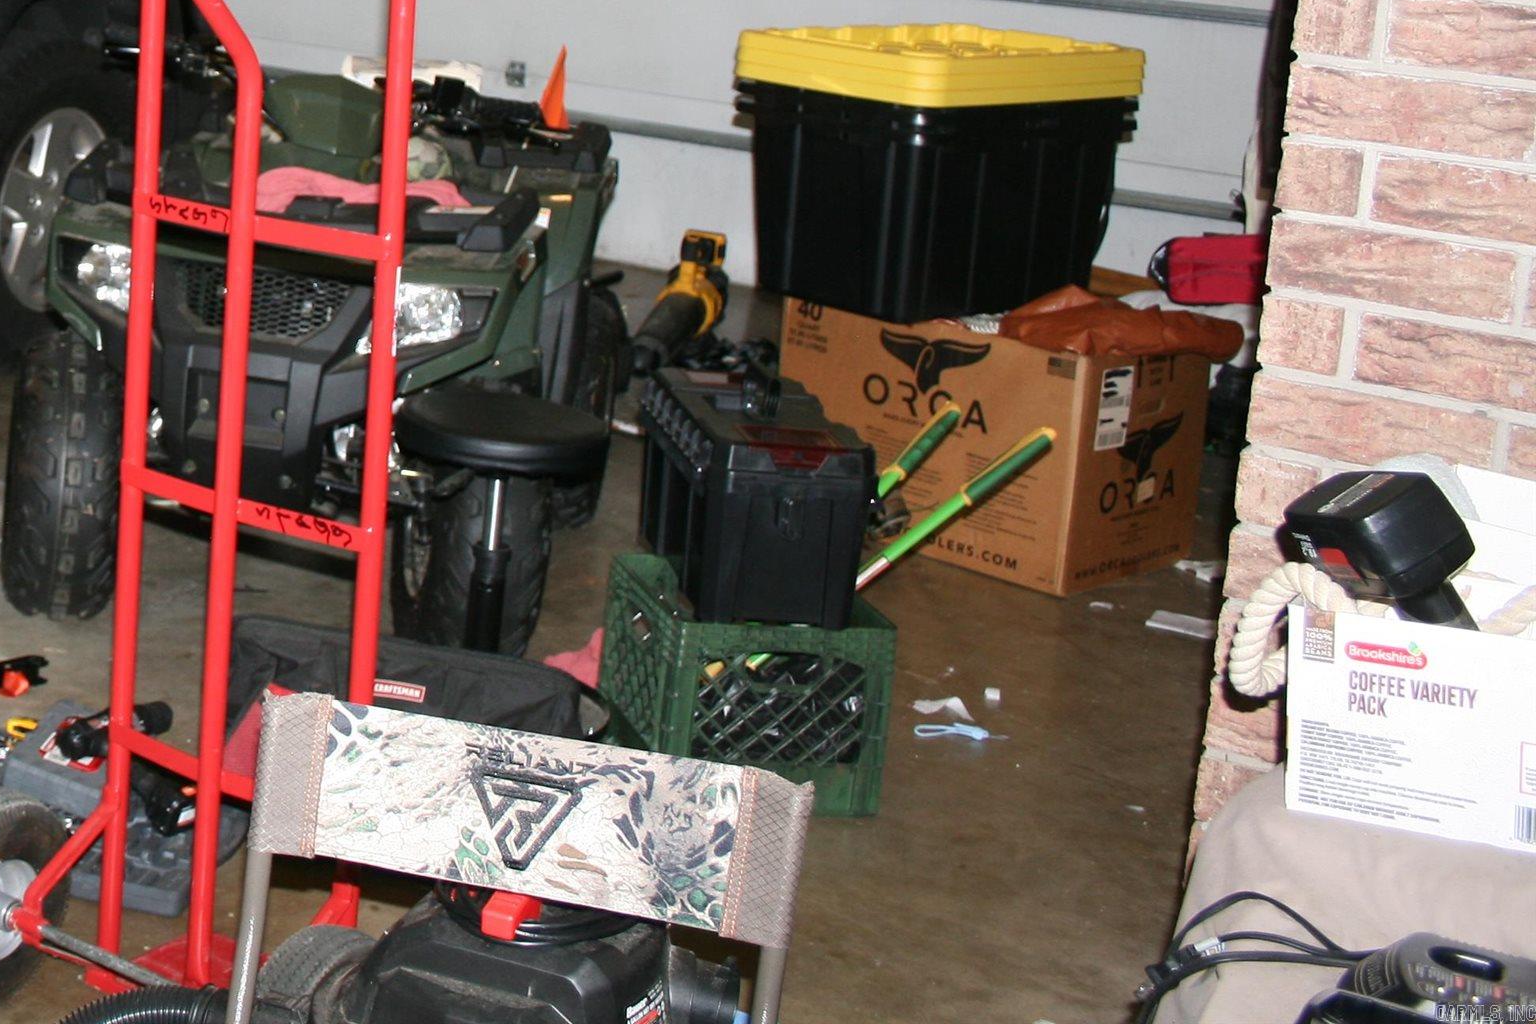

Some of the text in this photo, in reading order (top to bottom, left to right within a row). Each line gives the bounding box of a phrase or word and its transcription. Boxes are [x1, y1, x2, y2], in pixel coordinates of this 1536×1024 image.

[798, 298, 823, 321] 40
[1100, 469, 1175, 514] ORA
[1305, 631, 1333, 642] 100%
[1349, 670, 1478, 709] COFFEE VARIETY
[1348, 692, 1388, 717] PACK
